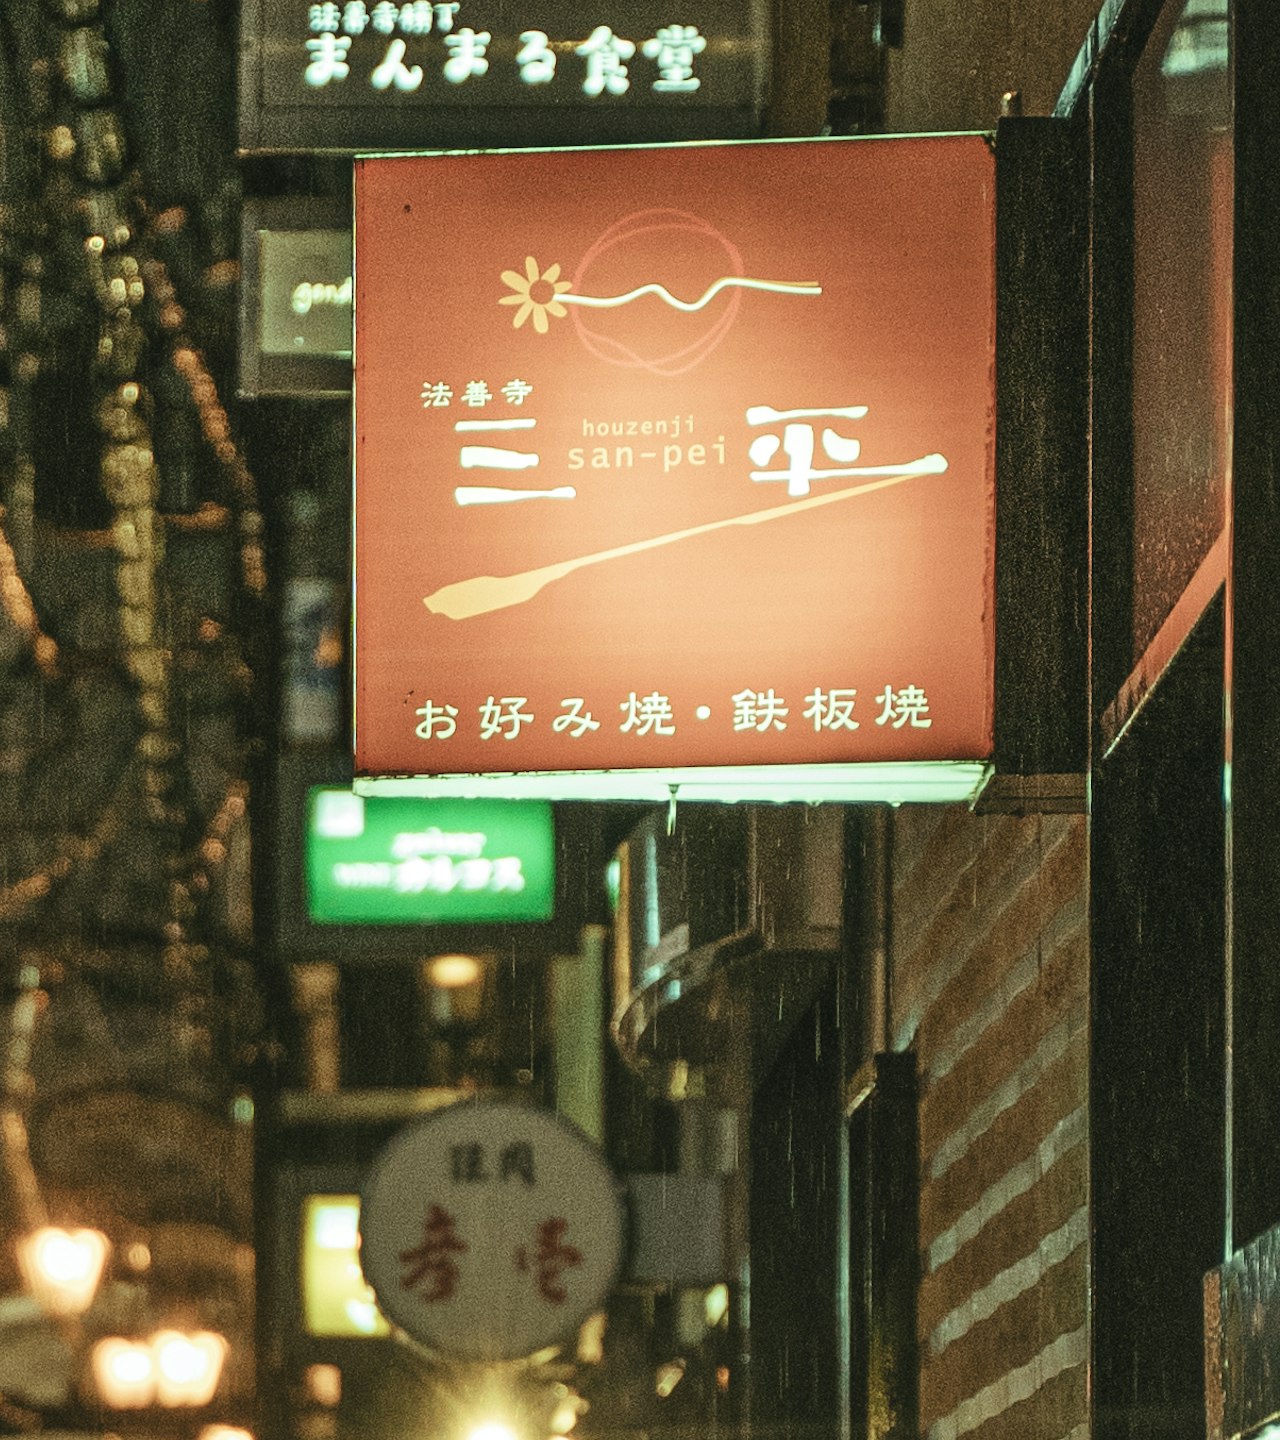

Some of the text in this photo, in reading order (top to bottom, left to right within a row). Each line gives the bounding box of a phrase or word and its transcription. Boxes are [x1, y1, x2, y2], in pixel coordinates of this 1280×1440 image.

[304, 24, 707, 97] まんまる食堂
[419, 378, 535, 410] 法善寺
[581, 414, 697, 439] houzenji
[454, 404, 950, 506] 三 平
[566, 435, 730, 474] san-pei
